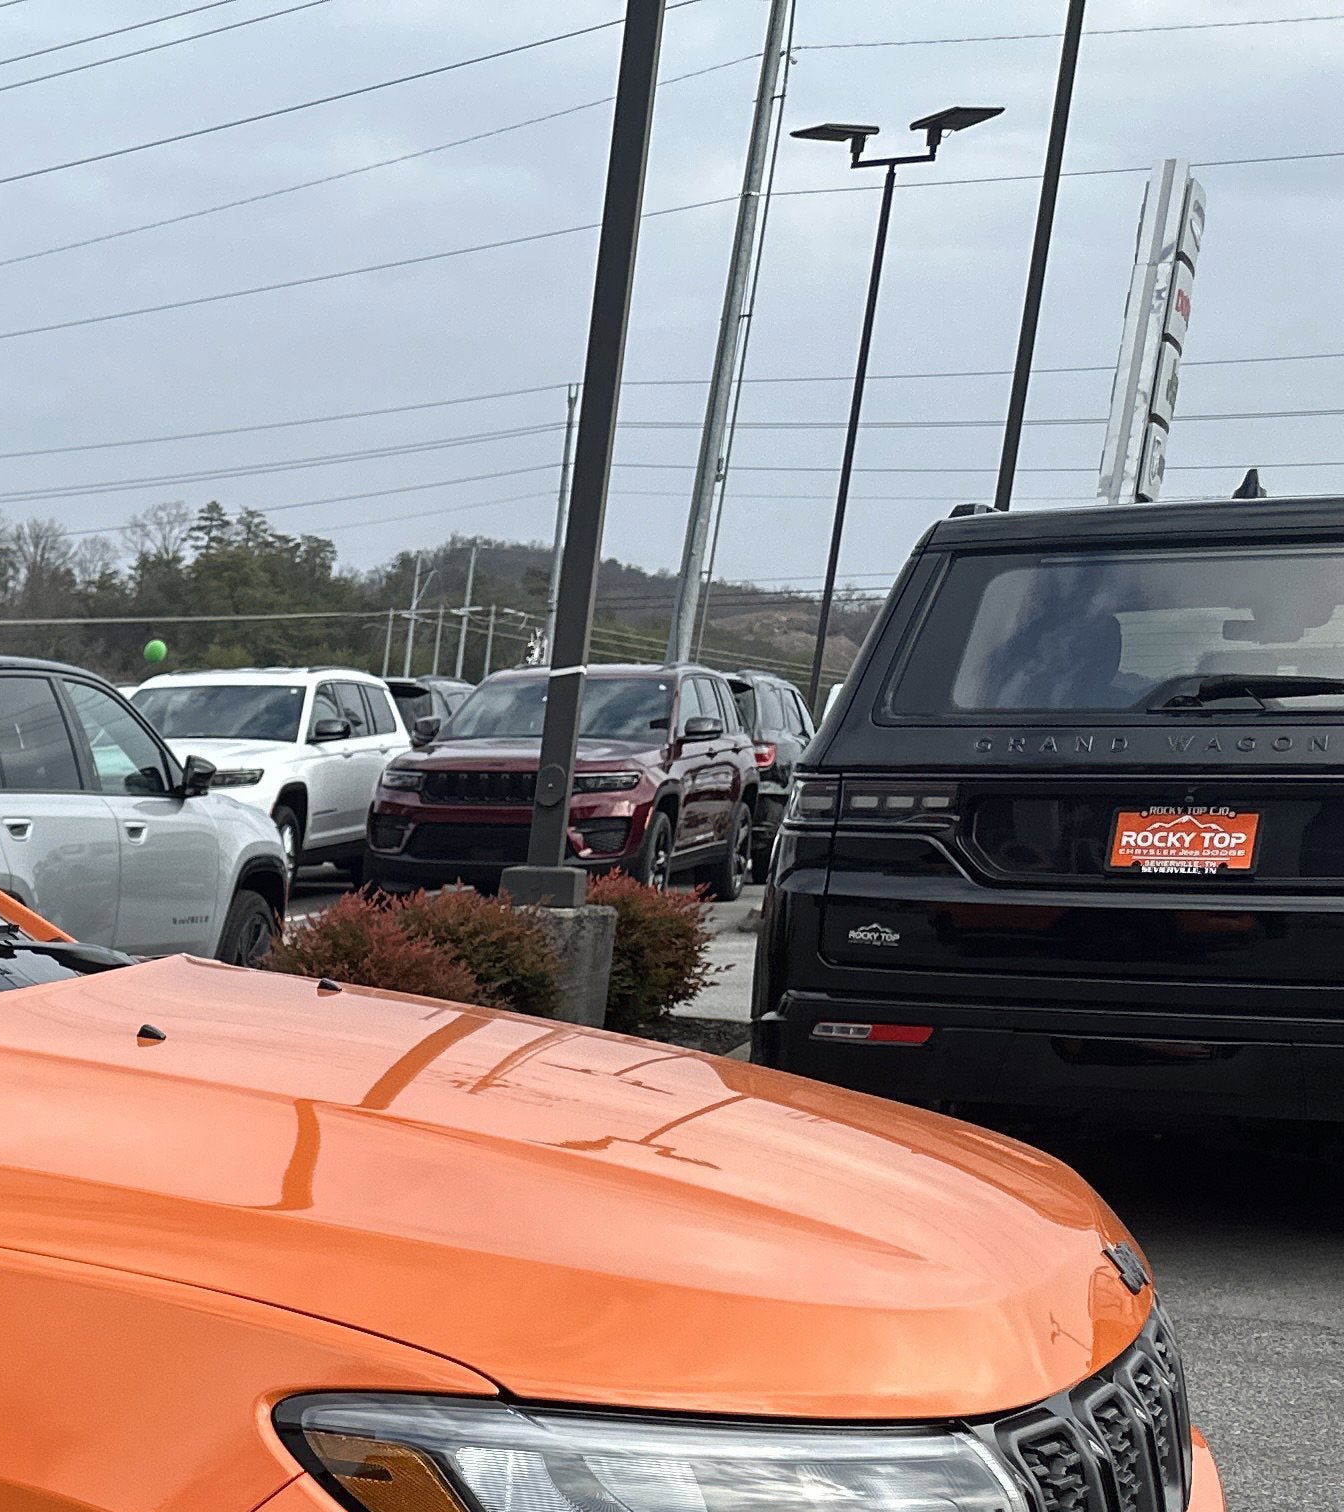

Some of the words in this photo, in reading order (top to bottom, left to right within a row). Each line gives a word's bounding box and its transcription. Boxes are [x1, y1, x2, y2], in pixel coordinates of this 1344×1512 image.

[974, 735, 1128, 752] GRAND
[1149, 806, 1183, 816] ROCKY
[1187, 806, 1207, 816] TOP
[1120, 831, 1196, 847] ROCKY
[1200, 832, 1247, 848] TOP
[1201, 849, 1246, 857] DODGE
[848, 929, 879, 941] ROCKY
[880, 932, 900, 942] TOP
